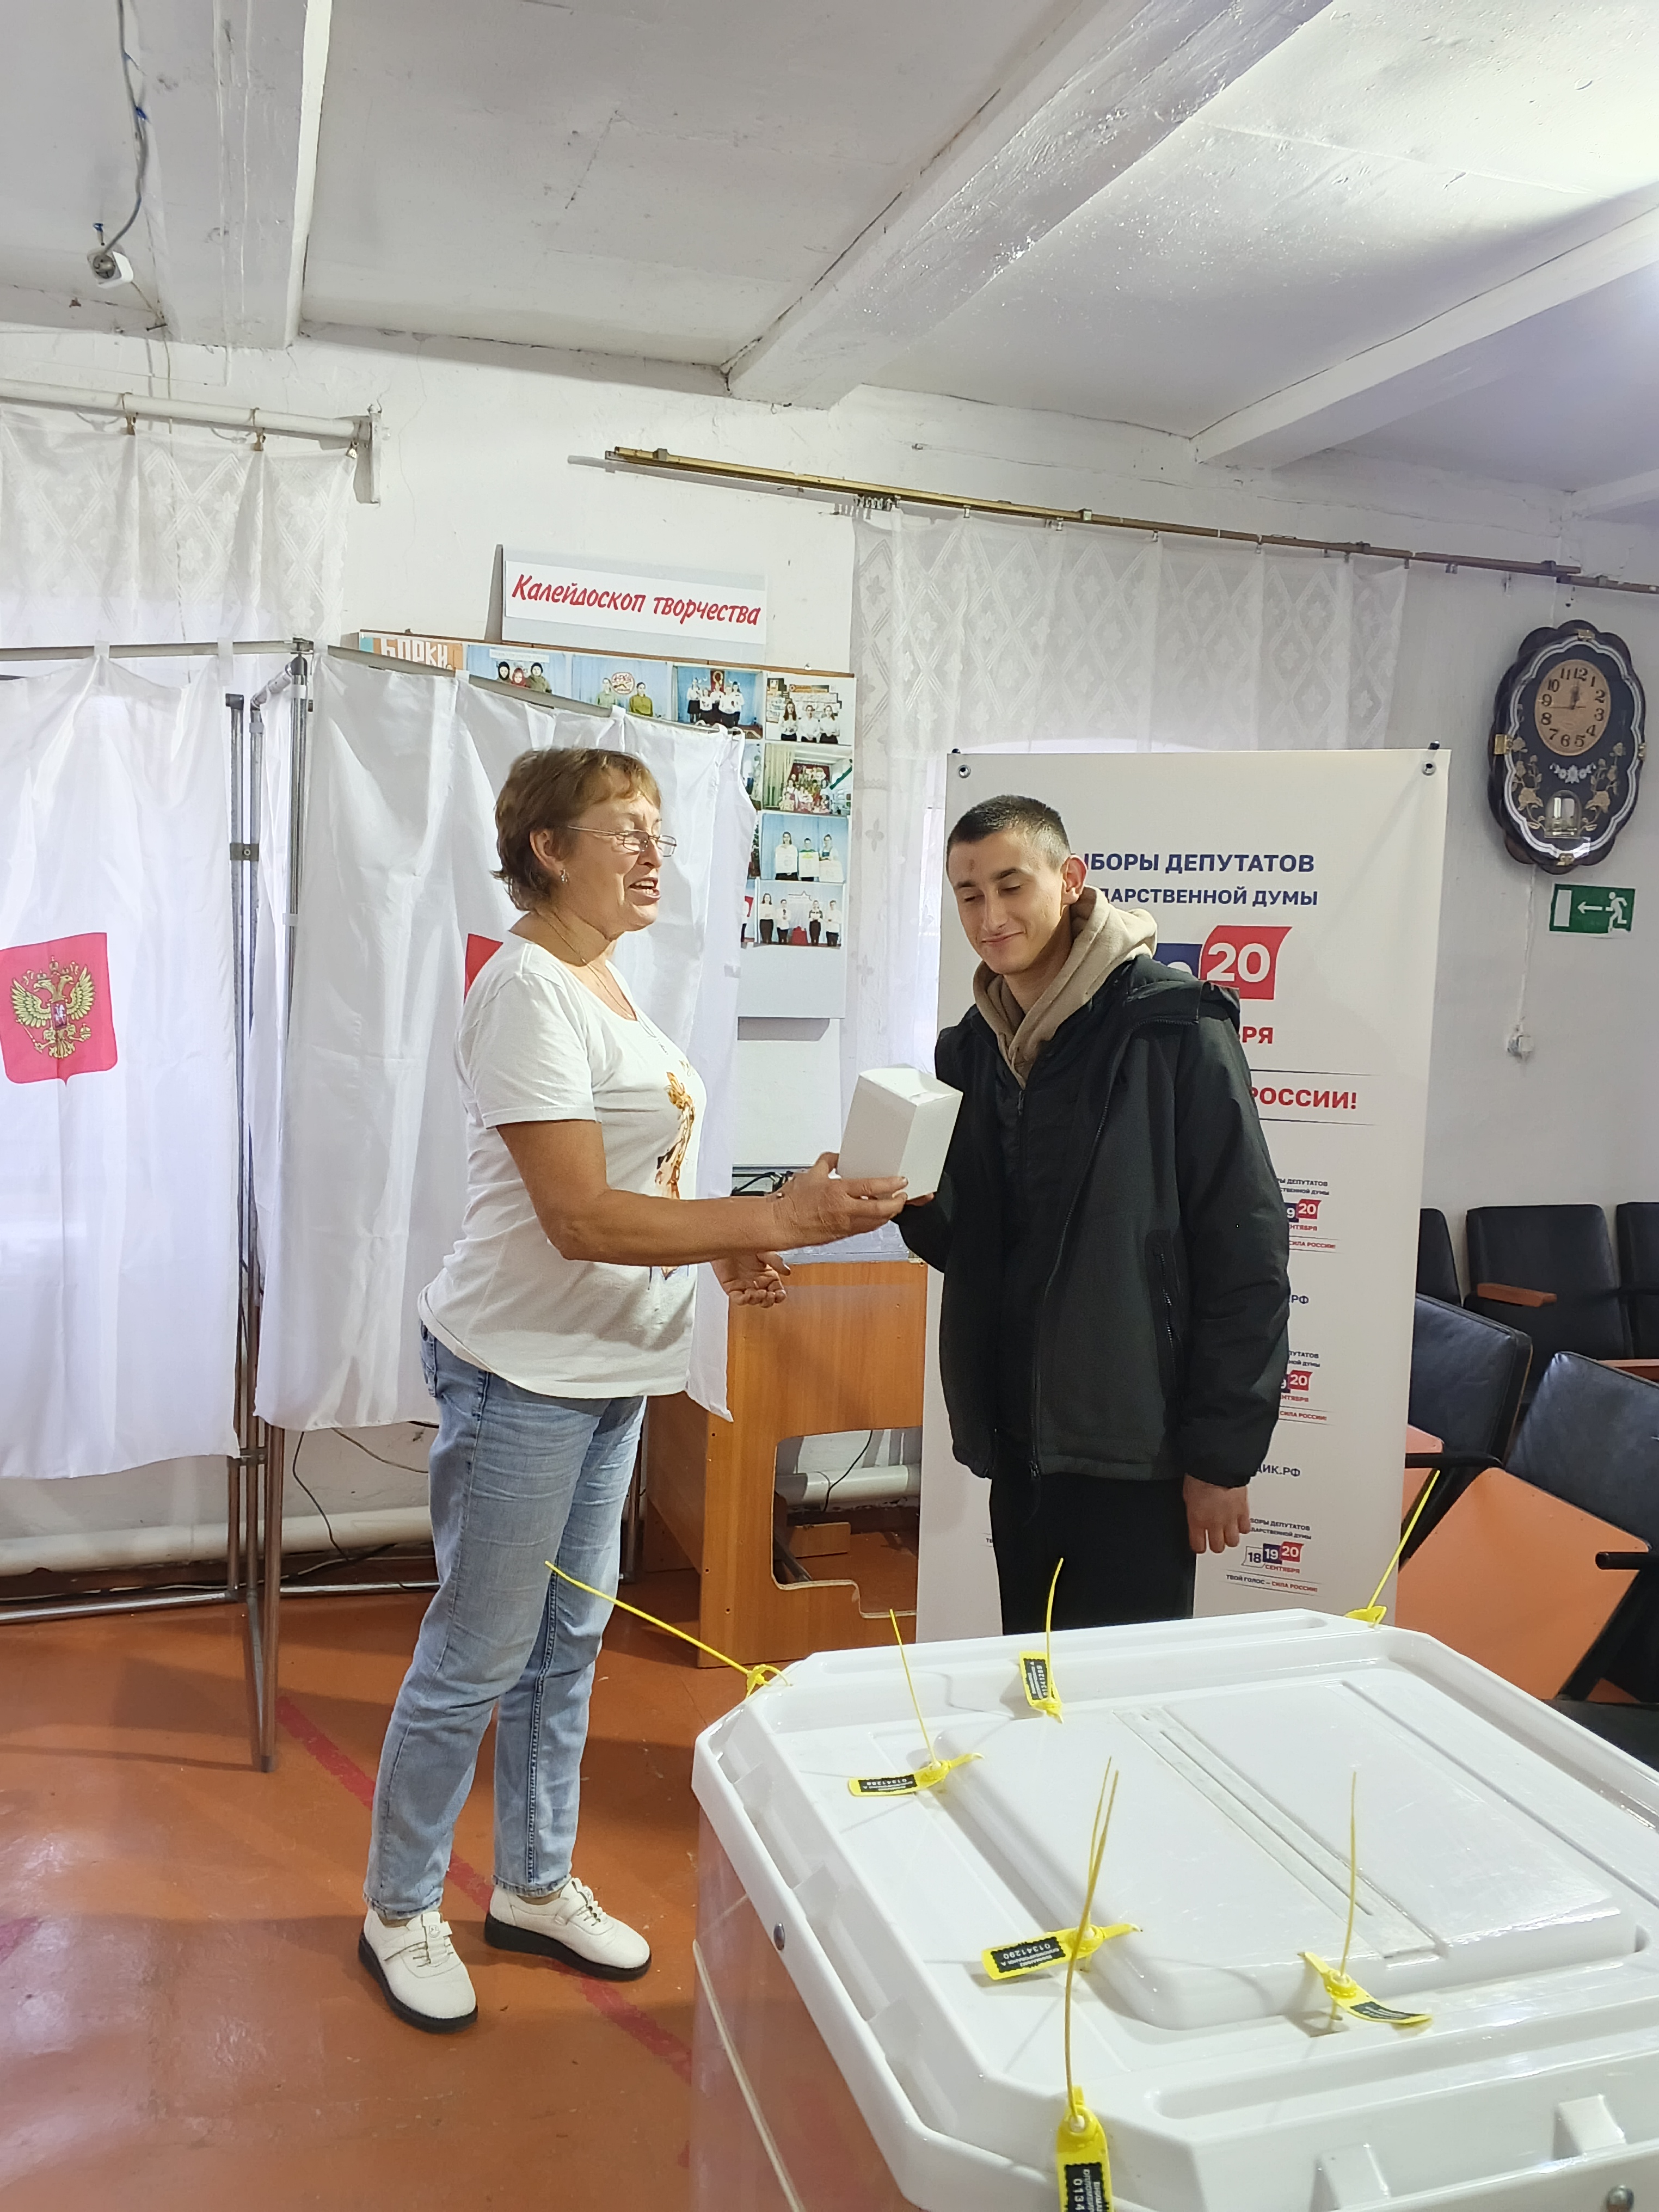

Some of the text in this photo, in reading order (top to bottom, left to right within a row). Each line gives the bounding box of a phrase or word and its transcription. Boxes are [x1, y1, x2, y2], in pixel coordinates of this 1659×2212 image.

[512, 574, 761, 625] Калейдоскоп творчества
[1560, 668, 1570, 679] 11
[1574, 668, 1588, 681] 12
[1547, 679, 1559, 692] 10
[1590, 676, 1595, 687] 1
[1542, 694, 1552, 706] 9
[1595, 690, 1605, 703] 2
[1541, 712, 1552, 725] 8
[1594, 708, 1605, 721] 3
[1549, 728, 1558, 740] 7
[1586, 724, 1595, 736] 4
[1560, 734, 1570, 747] 6
[1574, 735, 1586, 747] 5
[1165, 854, 1314, 874] ДЕПУТАТОВ
[1252, 890, 1318, 907] ДУМЫ
[1207, 942, 1270, 982] 20
[1238, 1026, 1273, 1044] РЯ
[1287, 1203, 1317, 1218] 9 20
[1289, 1374, 1307, 1386] 20
[1250, 1527, 1293, 1537] ДАРСТВЕННОЙ
[1270, 1521, 1311, 1531] ДЕПУТАТОВ
[1248, 1545, 1299, 1564] 18 19 20
[1264, 1564, 1300, 1574] СЕНТЯБРЯ
[1073, 2178, 1085, 2210] 0134
